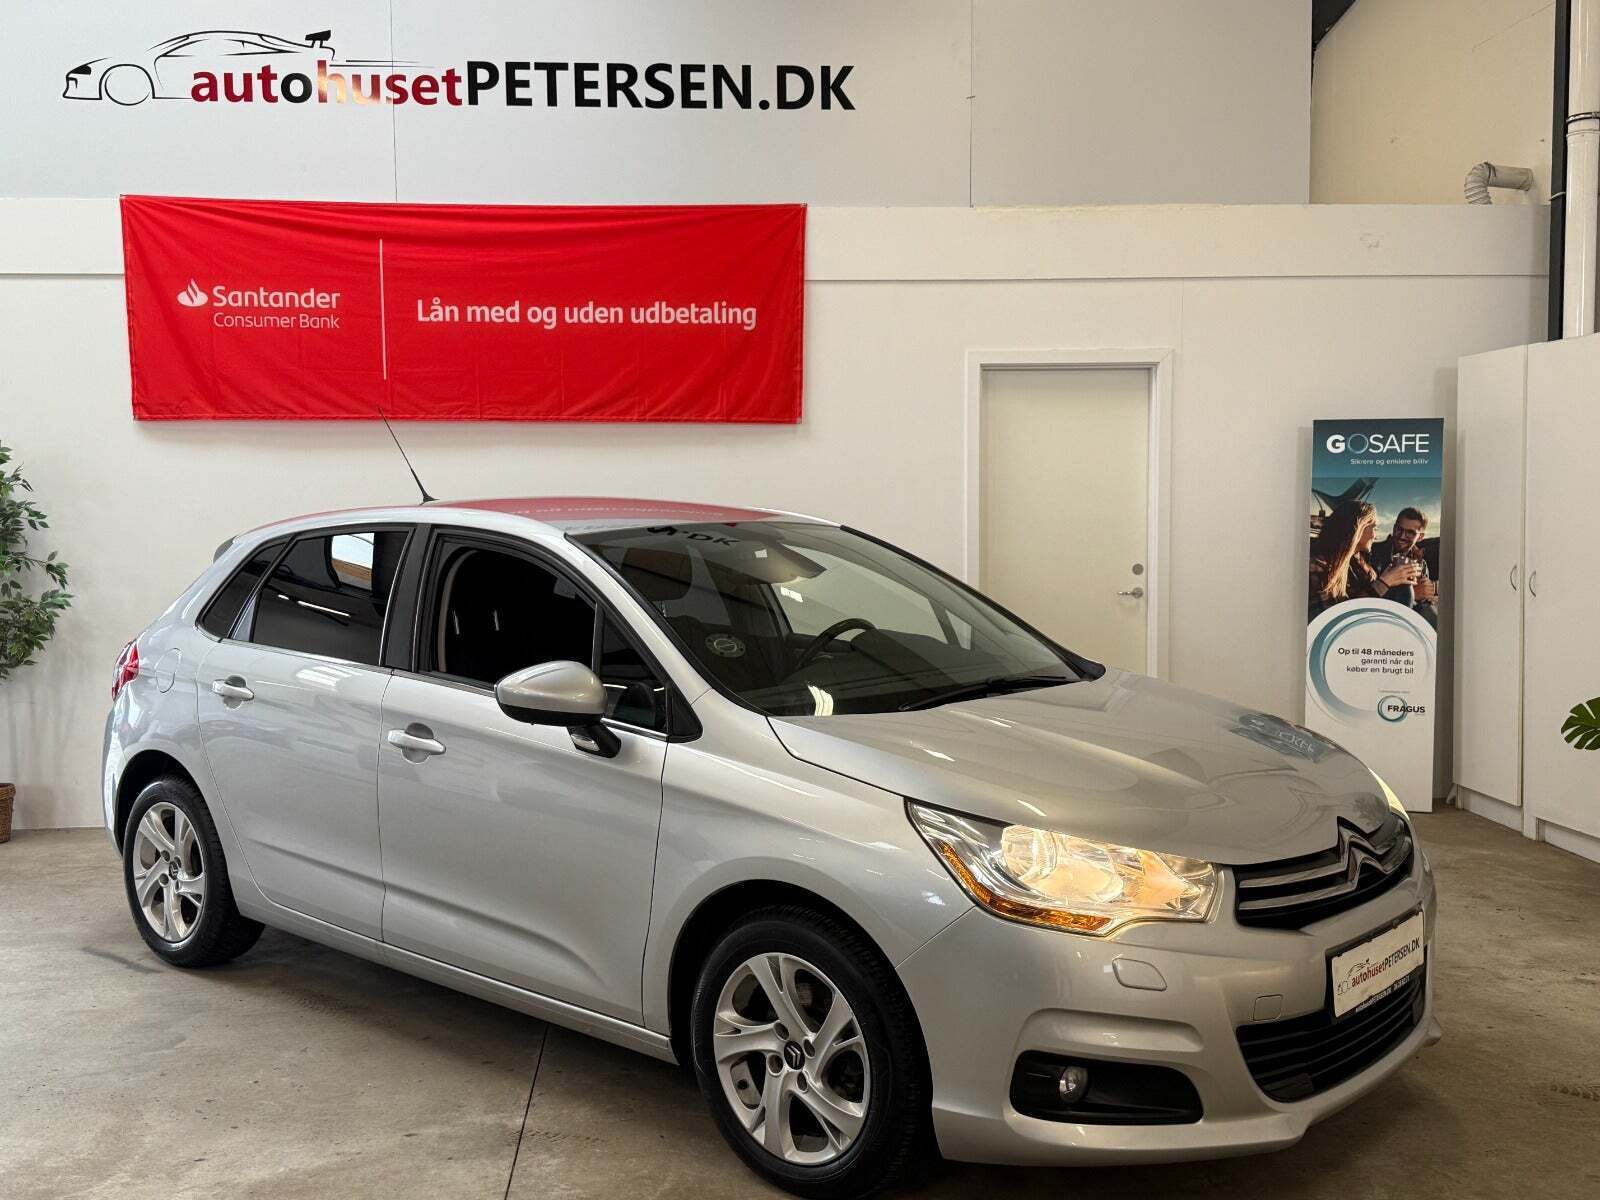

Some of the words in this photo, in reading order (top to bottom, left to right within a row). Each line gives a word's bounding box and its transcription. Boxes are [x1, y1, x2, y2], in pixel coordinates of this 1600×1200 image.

[191, 60, 856, 111] autohusetPETERSEN.DK
[212, 285, 341, 310] Santander
[213, 313, 298, 329] Consumer
[300, 313, 340, 329] Bank
[416, 298, 459, 324] Lån
[466, 299, 520, 324] med
[526, 306, 558, 330] og
[564, 299, 624, 325] uden
[630, 300, 758, 331] udbetaling
[1326, 433, 1429, 454] GOSAFE
[1337, 647, 1351, 656] Op
[1352, 647, 1360, 655] til
[1373, 648, 1414, 656] måneders
[1361, 657, 1388, 665] garanti
[1389, 657, 1402, 665] når
[1382, 667, 1402, 675] brugt
[1387, 704, 1426, 713] FRAGUS
